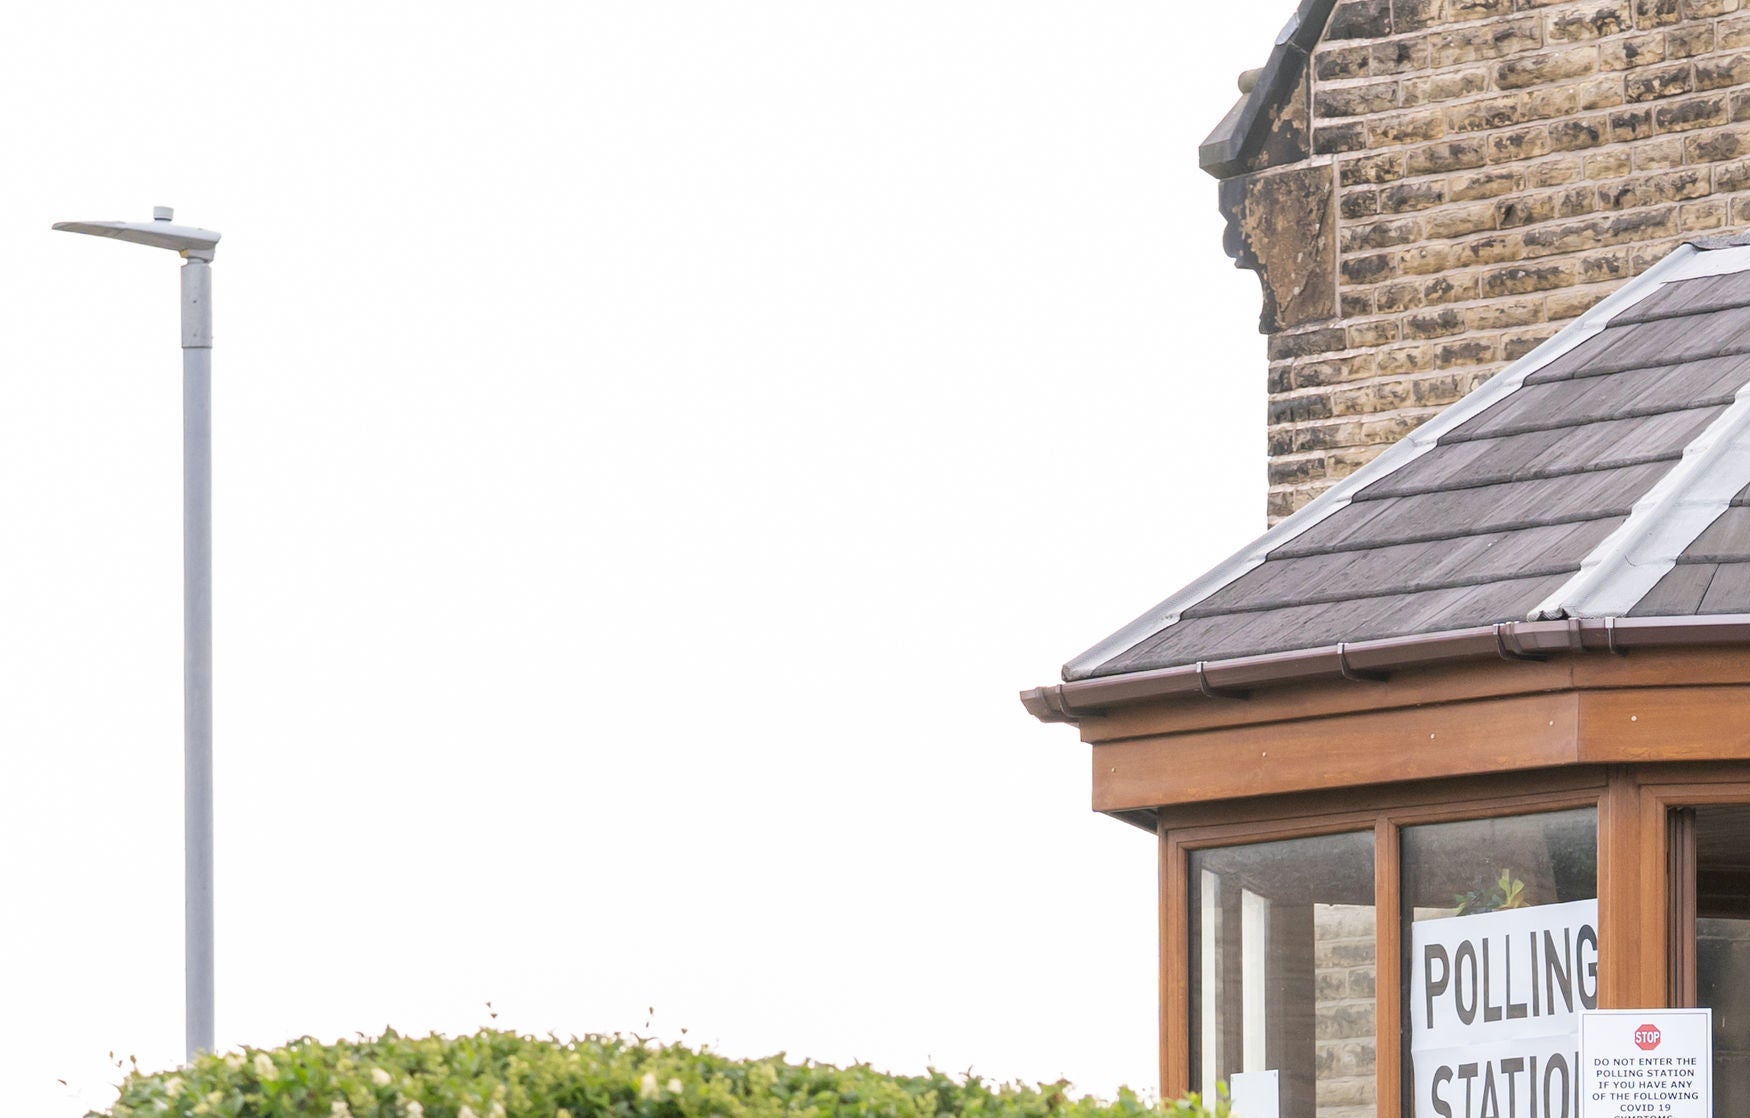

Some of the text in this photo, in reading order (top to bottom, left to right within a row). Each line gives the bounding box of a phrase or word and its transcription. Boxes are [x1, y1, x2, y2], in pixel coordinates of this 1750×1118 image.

[1424, 924, 1598, 1029] POLLING
[1635, 1031, 1660, 1043] STOP
[1594, 1058, 1697, 1066] DO NOT ENTER THE
[1596, 1069, 1695, 1078] POLLING STATION
[1599, 1081, 1692, 1089] IF YOU HAVE ANY
[1592, 1092, 1699, 1101] OF THE FOLLOWING
[1620, 1104, 1671, 1112] COVID 19
